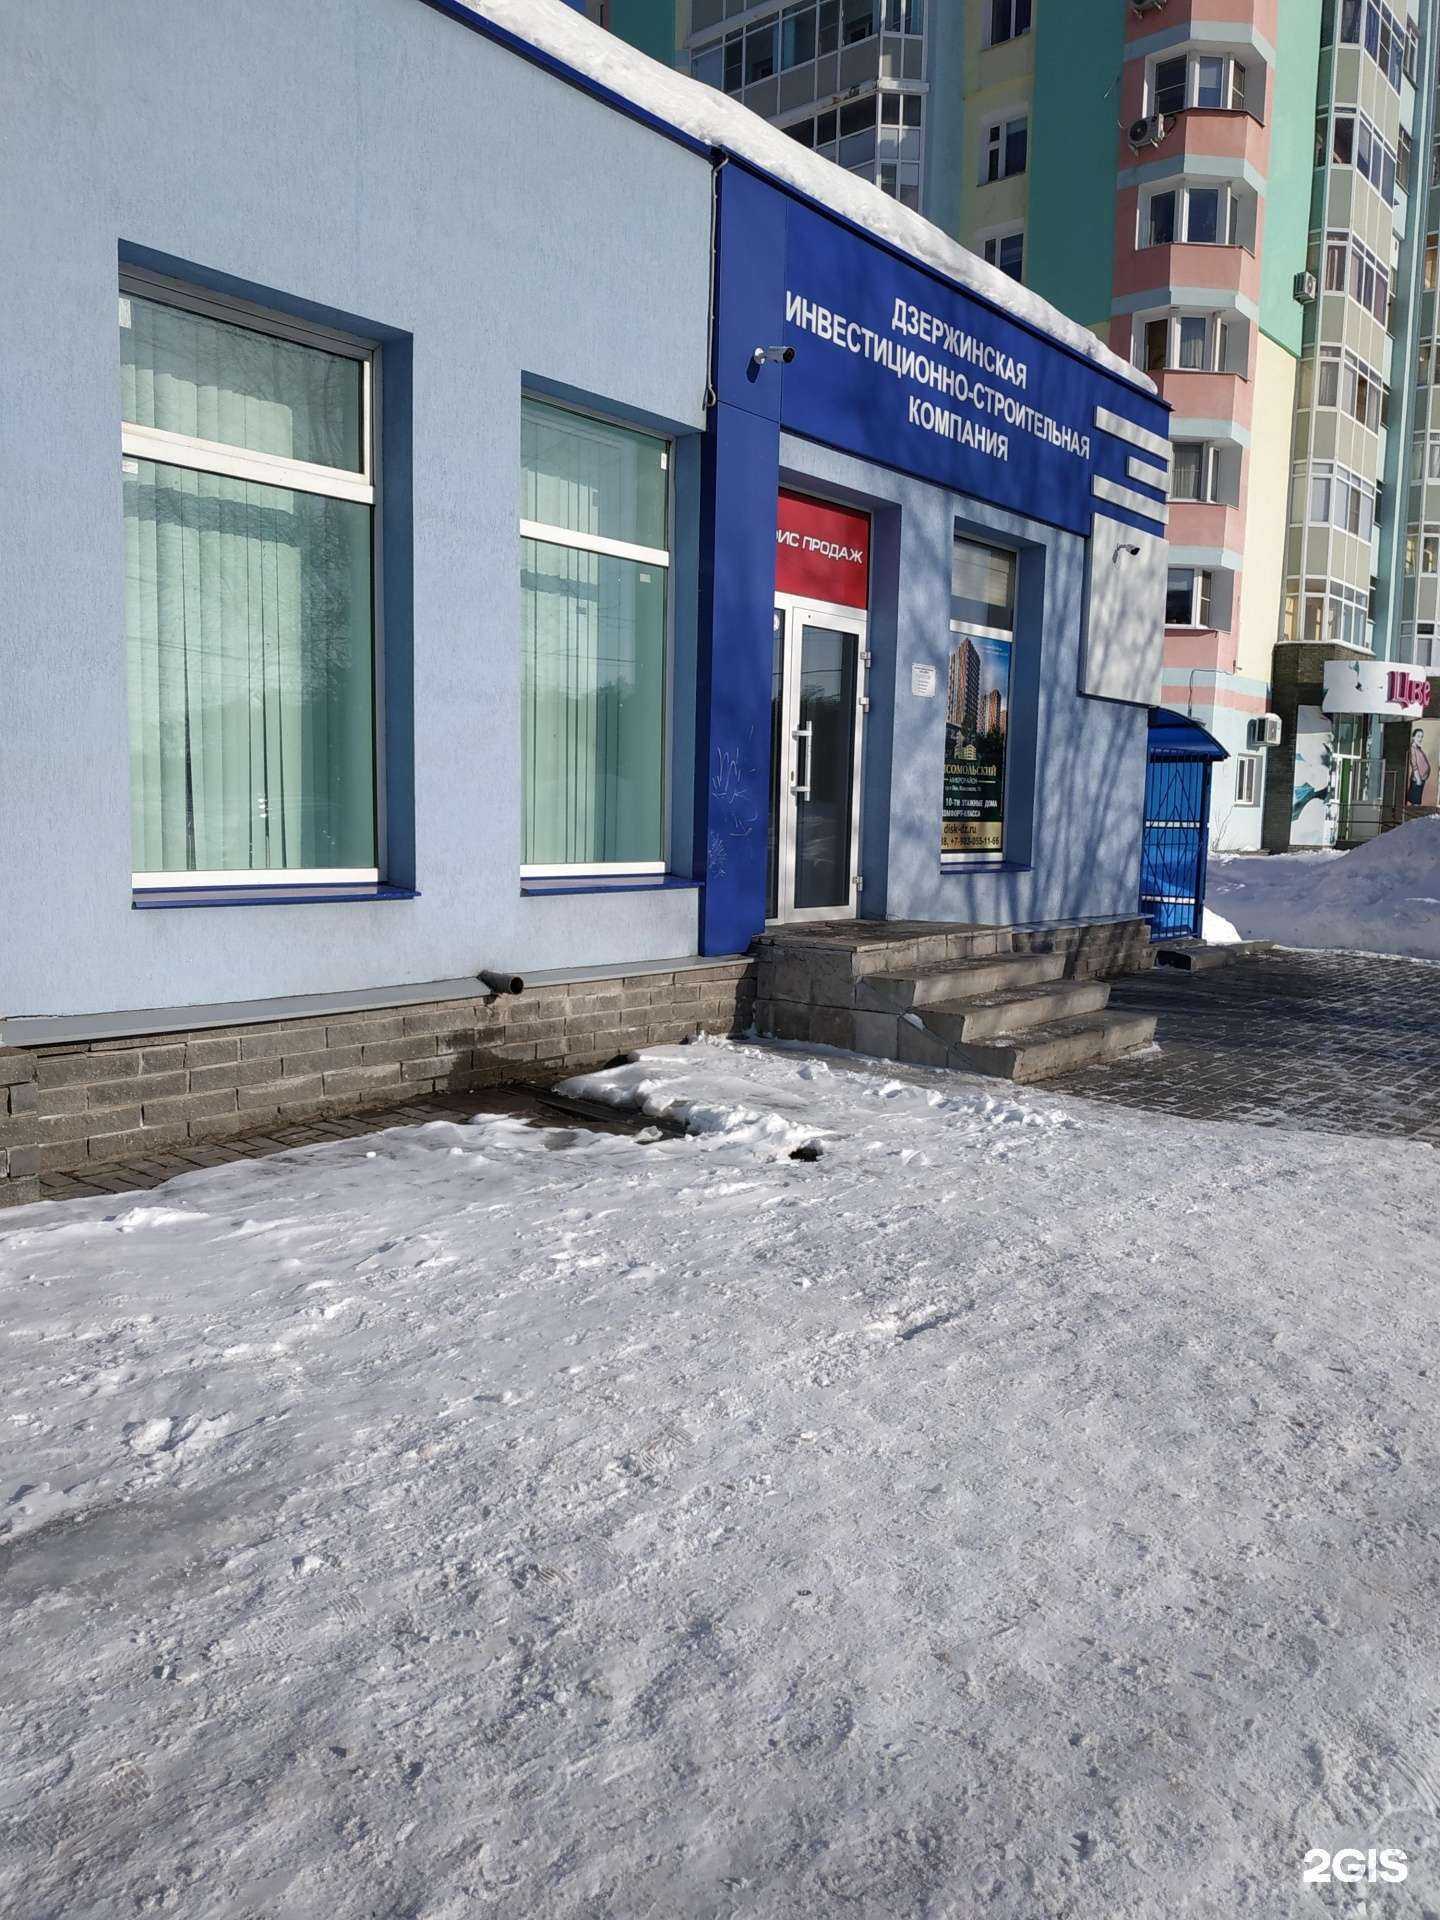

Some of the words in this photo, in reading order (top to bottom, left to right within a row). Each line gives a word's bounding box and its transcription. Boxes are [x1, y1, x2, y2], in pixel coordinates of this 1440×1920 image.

[785, 290, 1090, 461] ИНВЕСТИЦИОННО-СТРОИТЕЛЬНАЯ
[890, 297, 1028, 390] ДЗЕРЖИНСКАЯ
[908, 395, 1009, 462] КОМПАНИЯ
[776, 529, 800, 547] ИС
[802, 535, 863, 564] ПРОДАЖ
